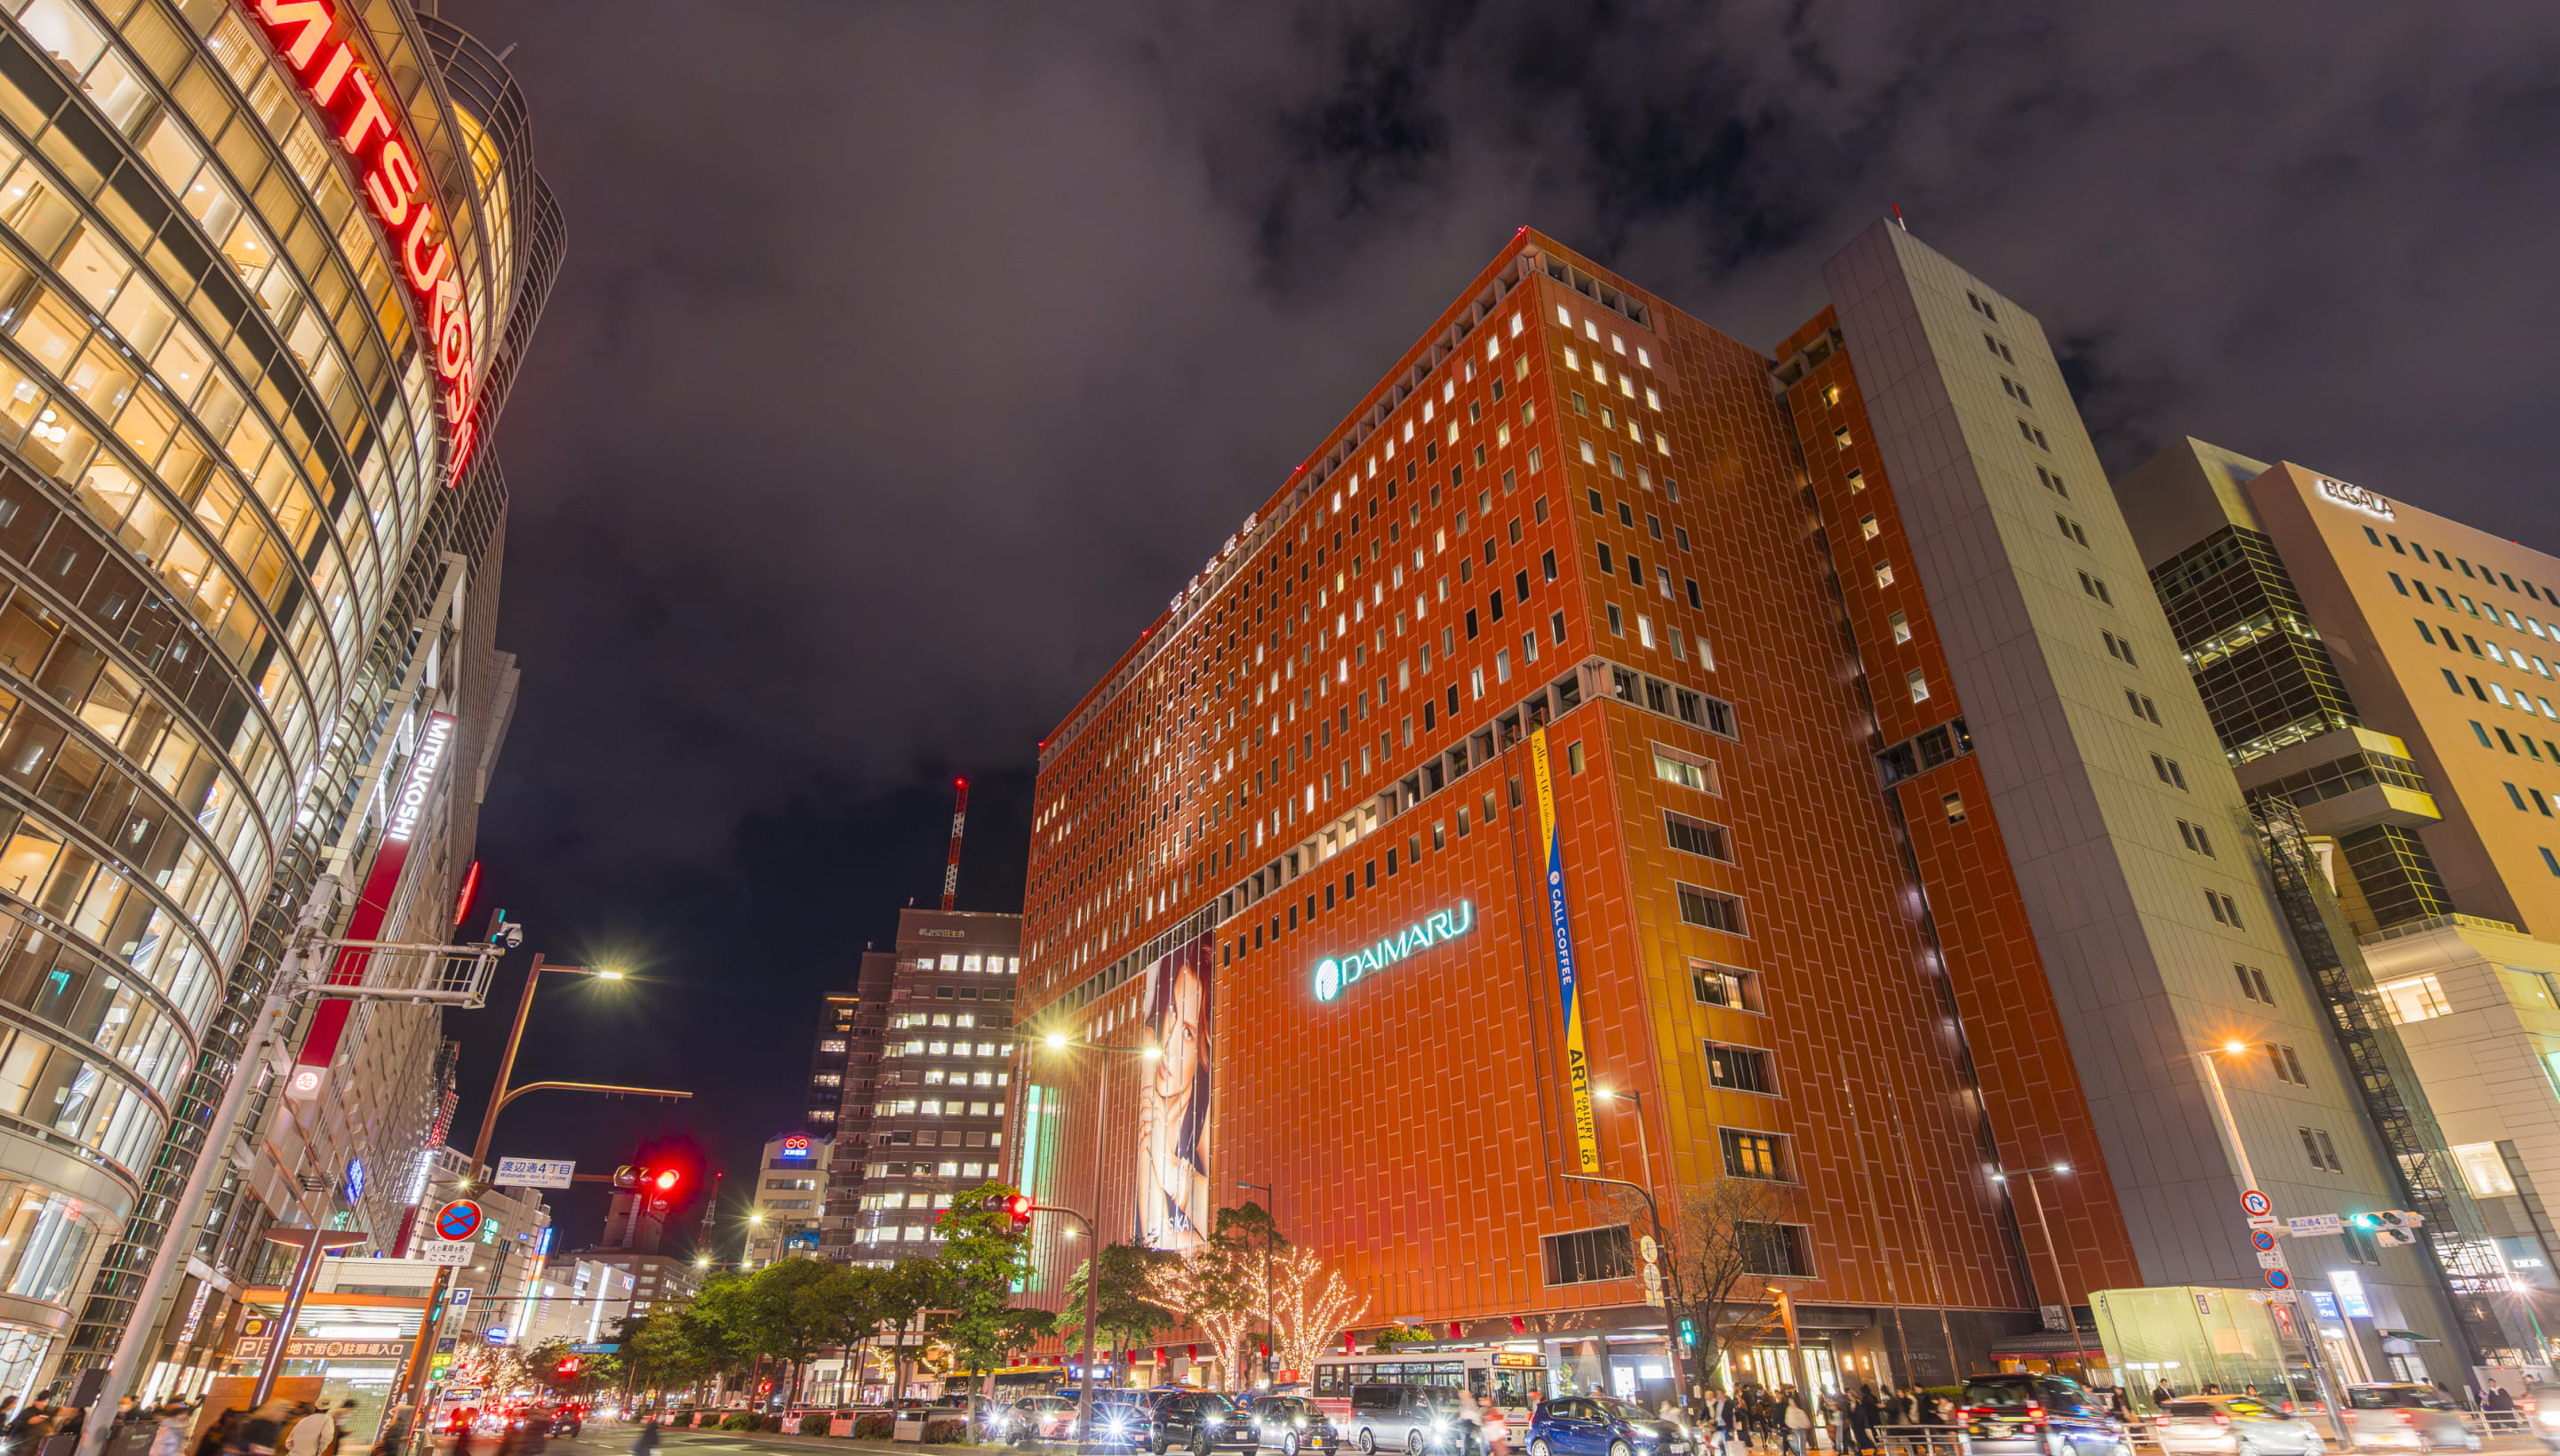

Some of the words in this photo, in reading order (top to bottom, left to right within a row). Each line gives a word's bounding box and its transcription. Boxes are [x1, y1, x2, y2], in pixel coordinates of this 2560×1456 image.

[2322, 479, 2396, 518] ELGALA
[389, 719, 450, 841] MITSUKOSHI
[1552, 889, 1564, 925] CALL
[1341, 900, 1469, 985] DAIMARU
[1557, 927, 1572, 985] COFFEE
[1570, 1049, 1588, 1095] ART
[1577, 1107, 1586, 1140] CAFE
[1581, 1097, 1593, 1140] GALLERY
[500, 1161, 571, 1175] 渡辺通4丁目
[429, 1254, 464, 1262] ここから
[455, 1291, 467, 1304] P
[239, 1341, 257, 1356] P
